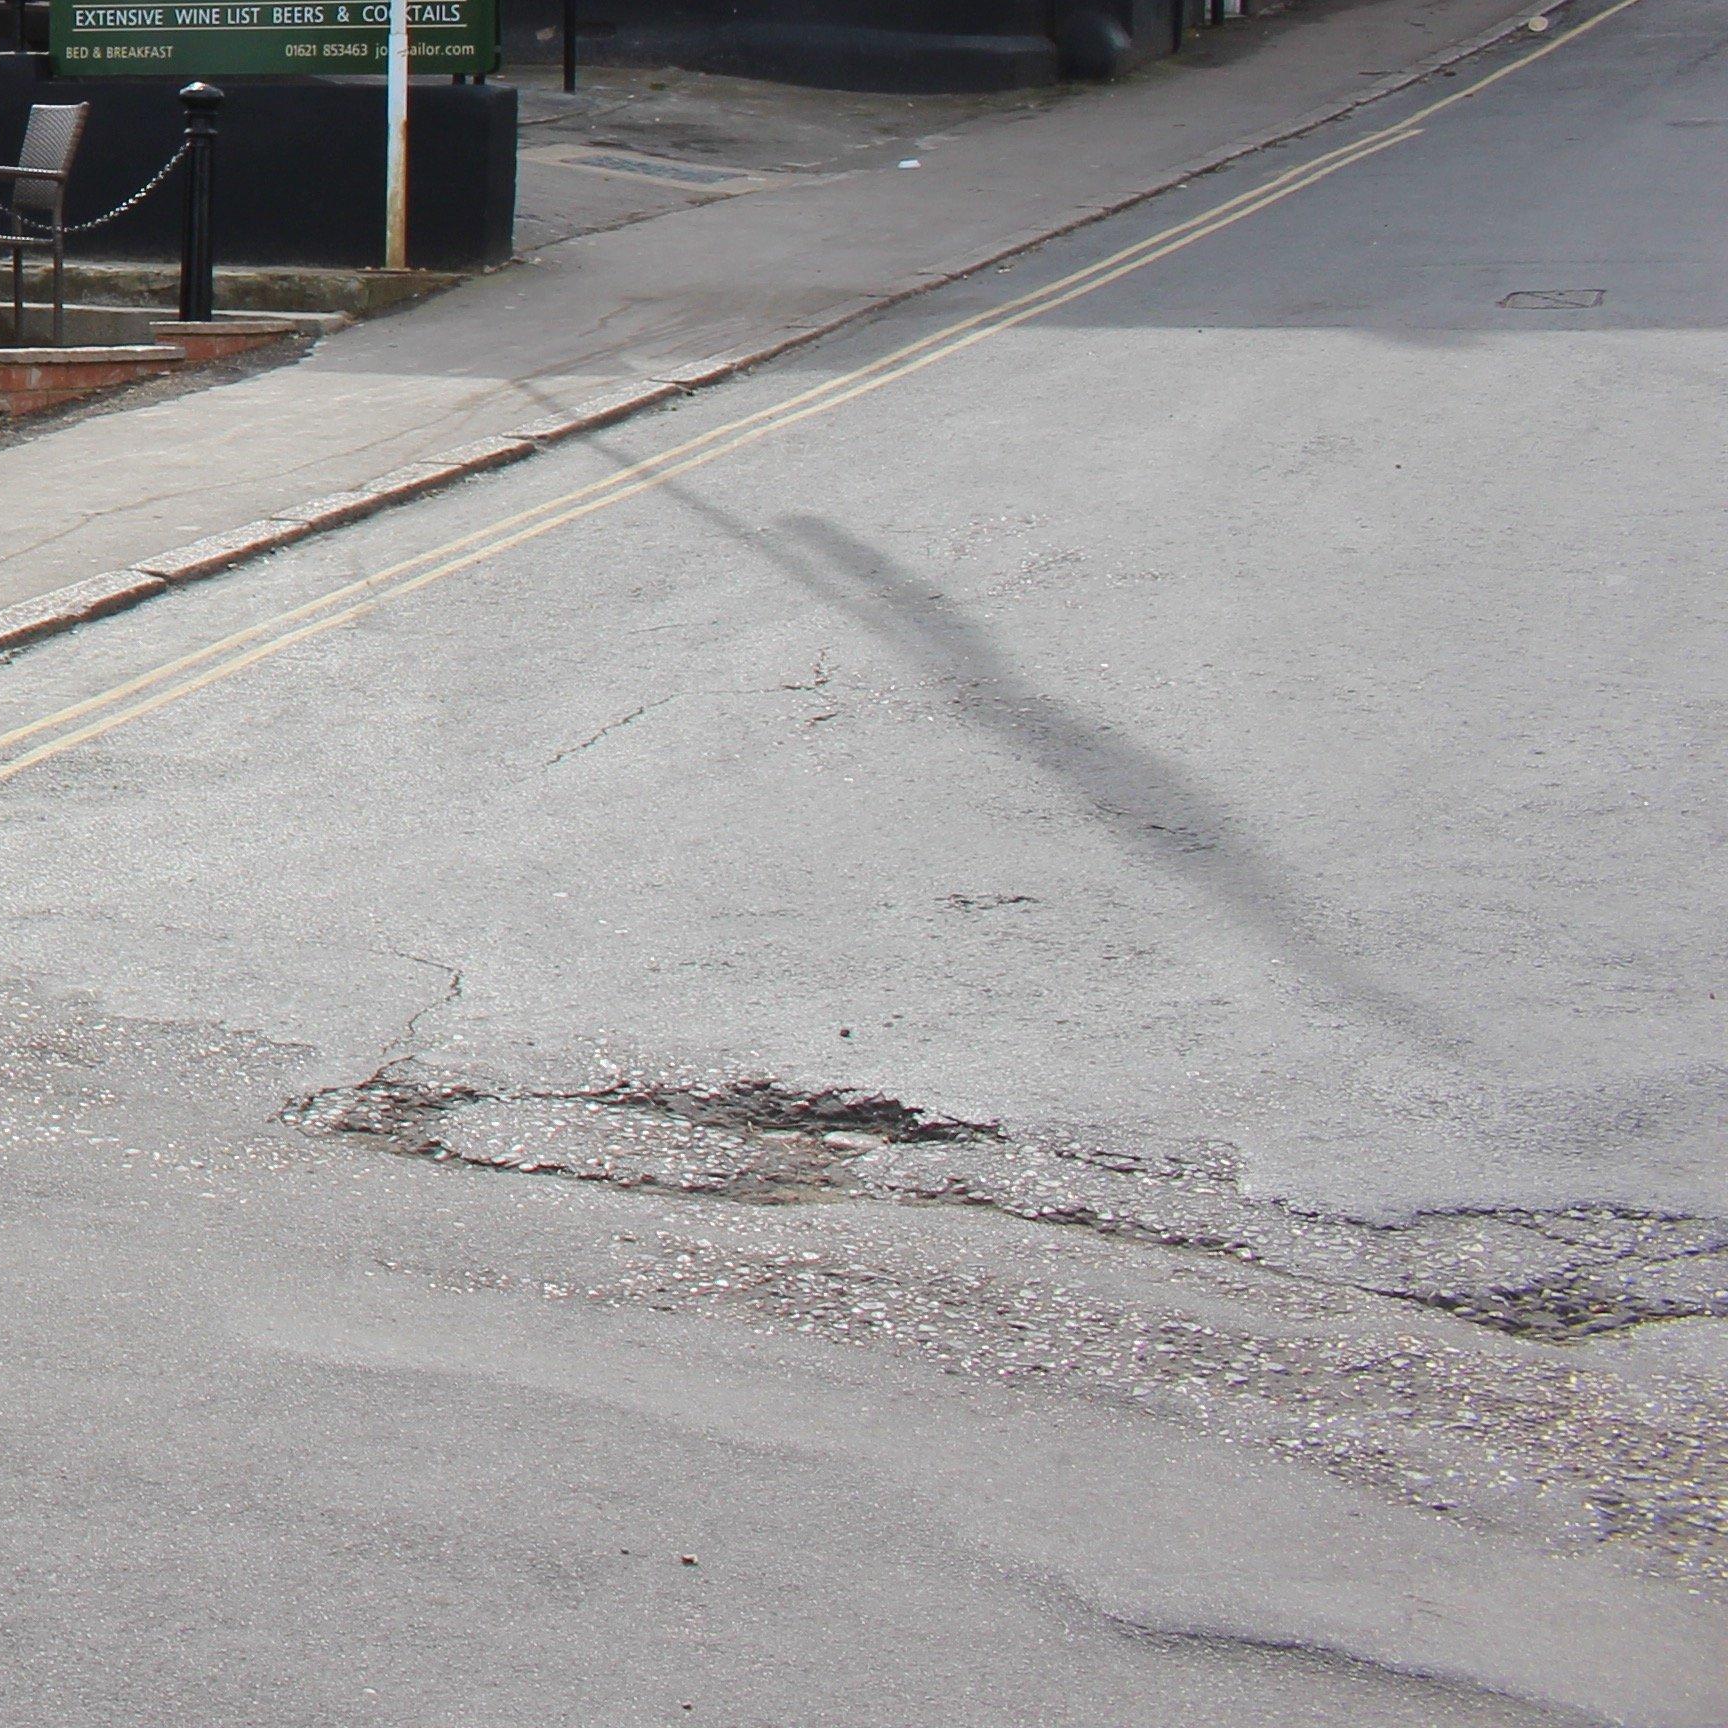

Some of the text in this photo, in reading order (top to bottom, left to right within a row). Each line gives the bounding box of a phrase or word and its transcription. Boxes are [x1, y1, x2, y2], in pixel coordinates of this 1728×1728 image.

[75, 4, 460, 26] EXTENSIVE WINE LIST BEERS & COKTAILS
[66, 45, 173, 59] BED & BREAKFAST
[285, 42, 474, 59] 01621 853463 joailor.com
